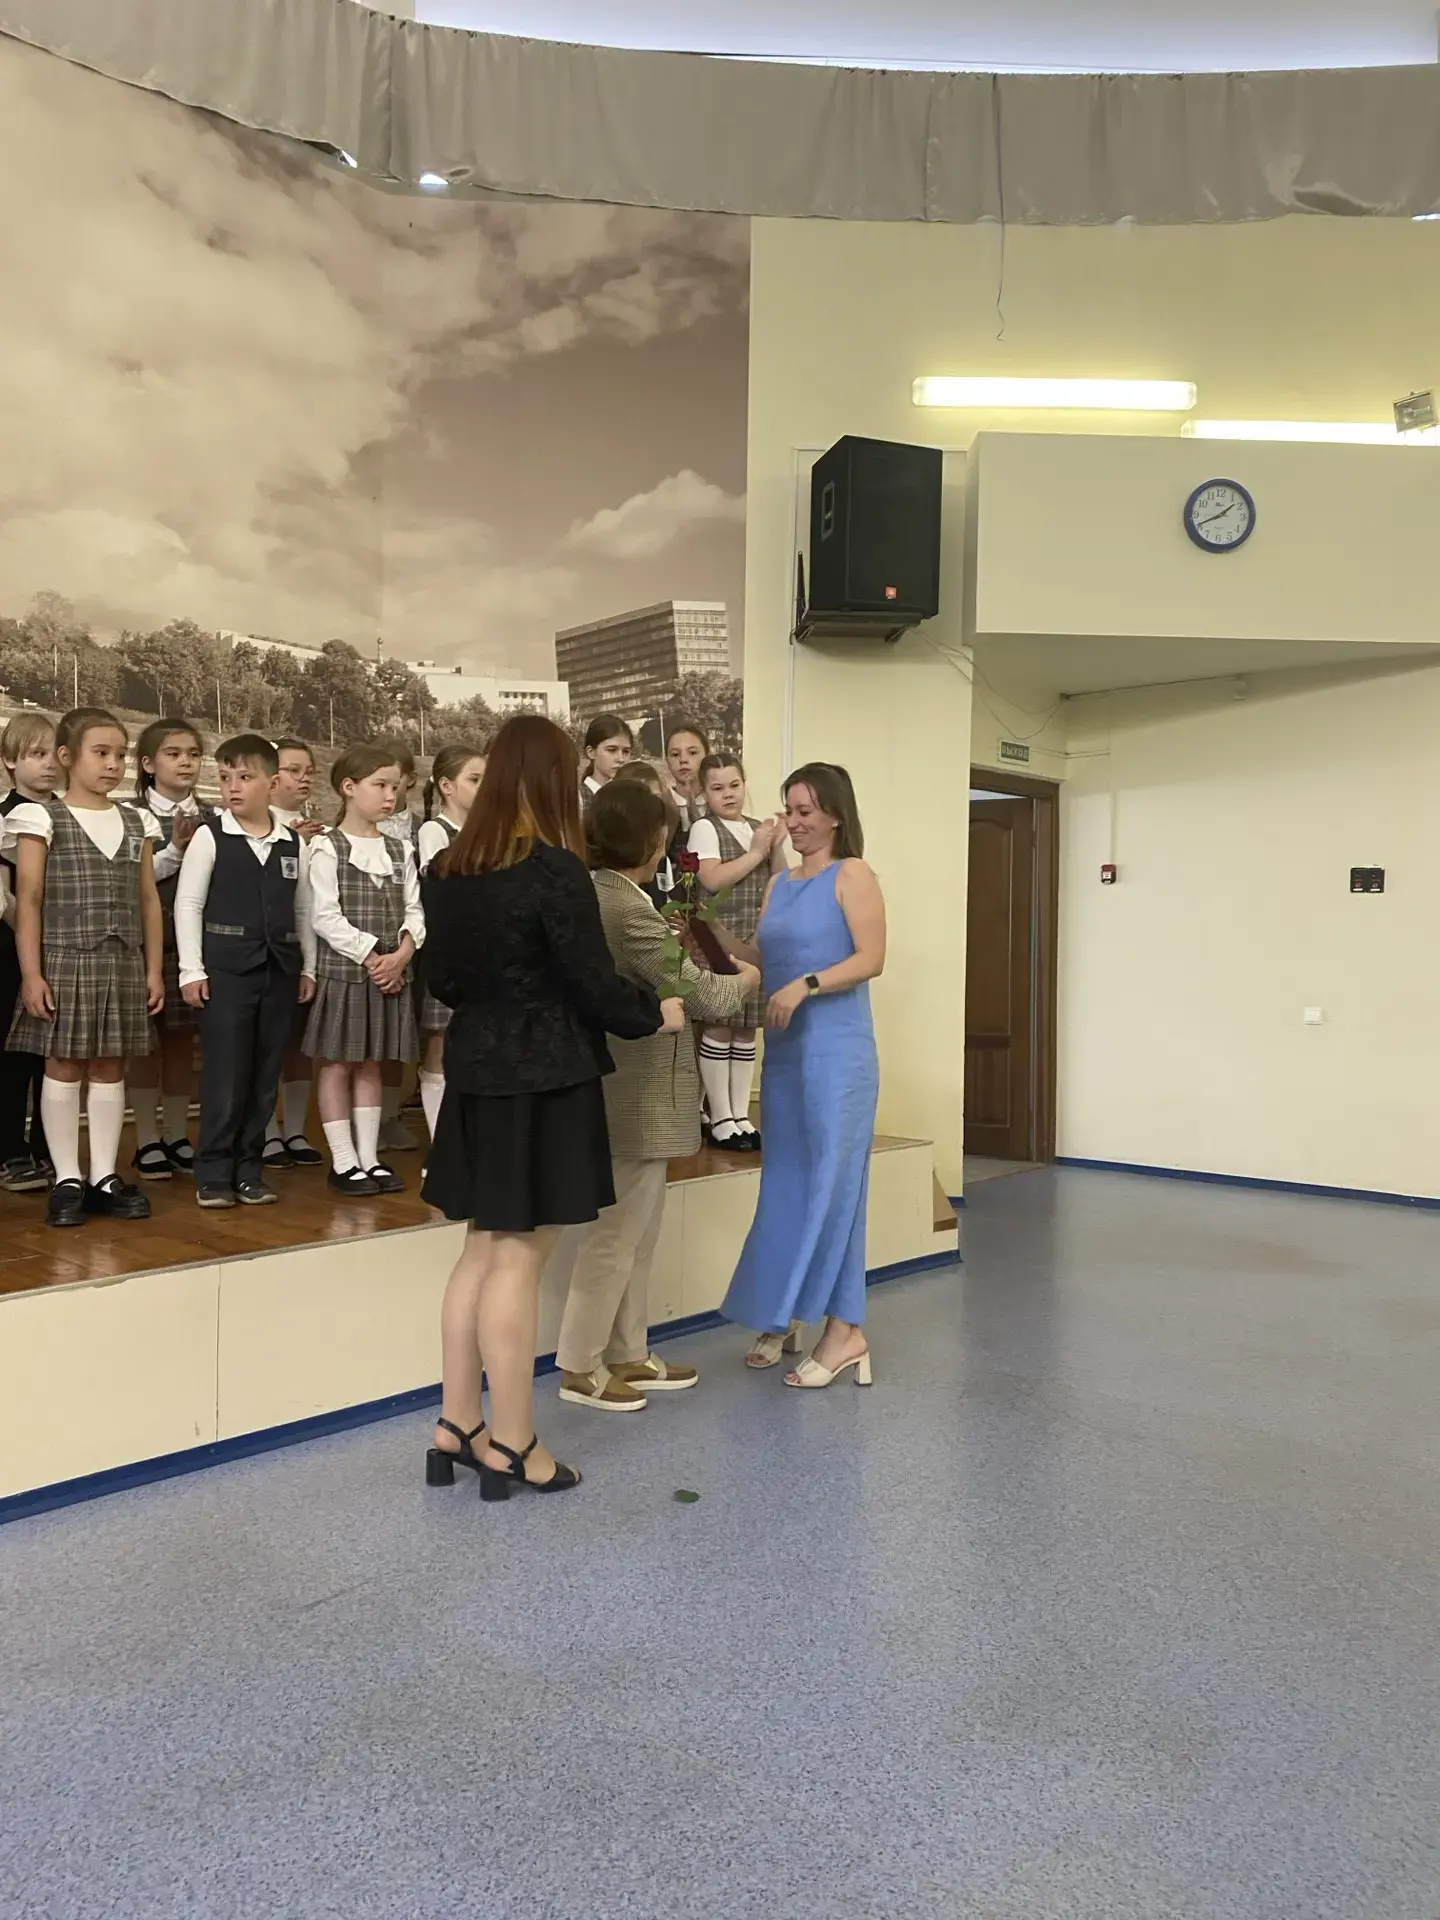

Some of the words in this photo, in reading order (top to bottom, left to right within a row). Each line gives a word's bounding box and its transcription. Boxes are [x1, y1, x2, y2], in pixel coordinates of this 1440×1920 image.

[1215, 489, 1226, 497] 12
[1198, 500, 1209, 509] 10
[1193, 511, 1200, 520] 9
[1002, 744, 1028, 759] ВЫХОД
